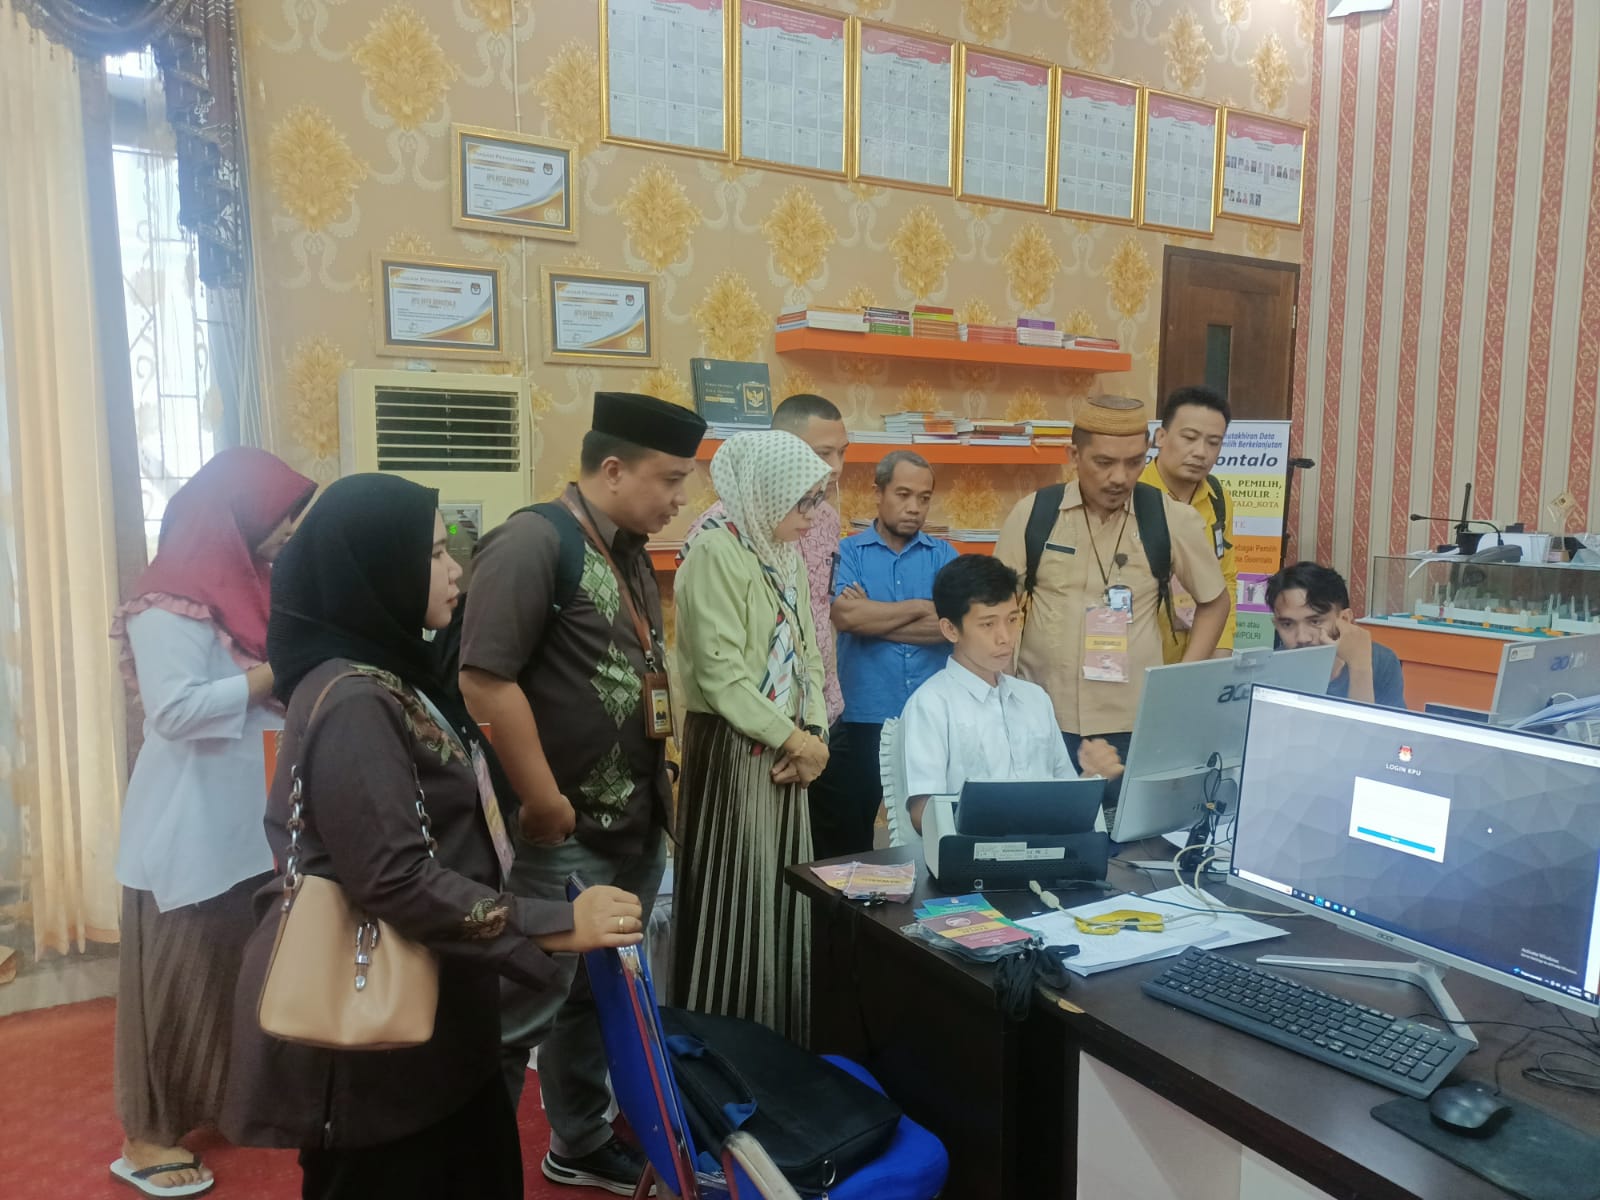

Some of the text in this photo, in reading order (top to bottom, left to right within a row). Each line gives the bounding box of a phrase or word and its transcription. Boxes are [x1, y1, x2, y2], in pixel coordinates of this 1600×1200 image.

[1224, 432, 1275, 440] utakhiran Data
[1238, 441, 1282, 450] Berkelanjutan
[1216, 453, 1278, 467] ontalo
[1239, 480, 1282, 489] PEMILIH,
[1229, 490, 1270, 498] RMULIR
[1385, 763, 1406, 773] LOGIN
